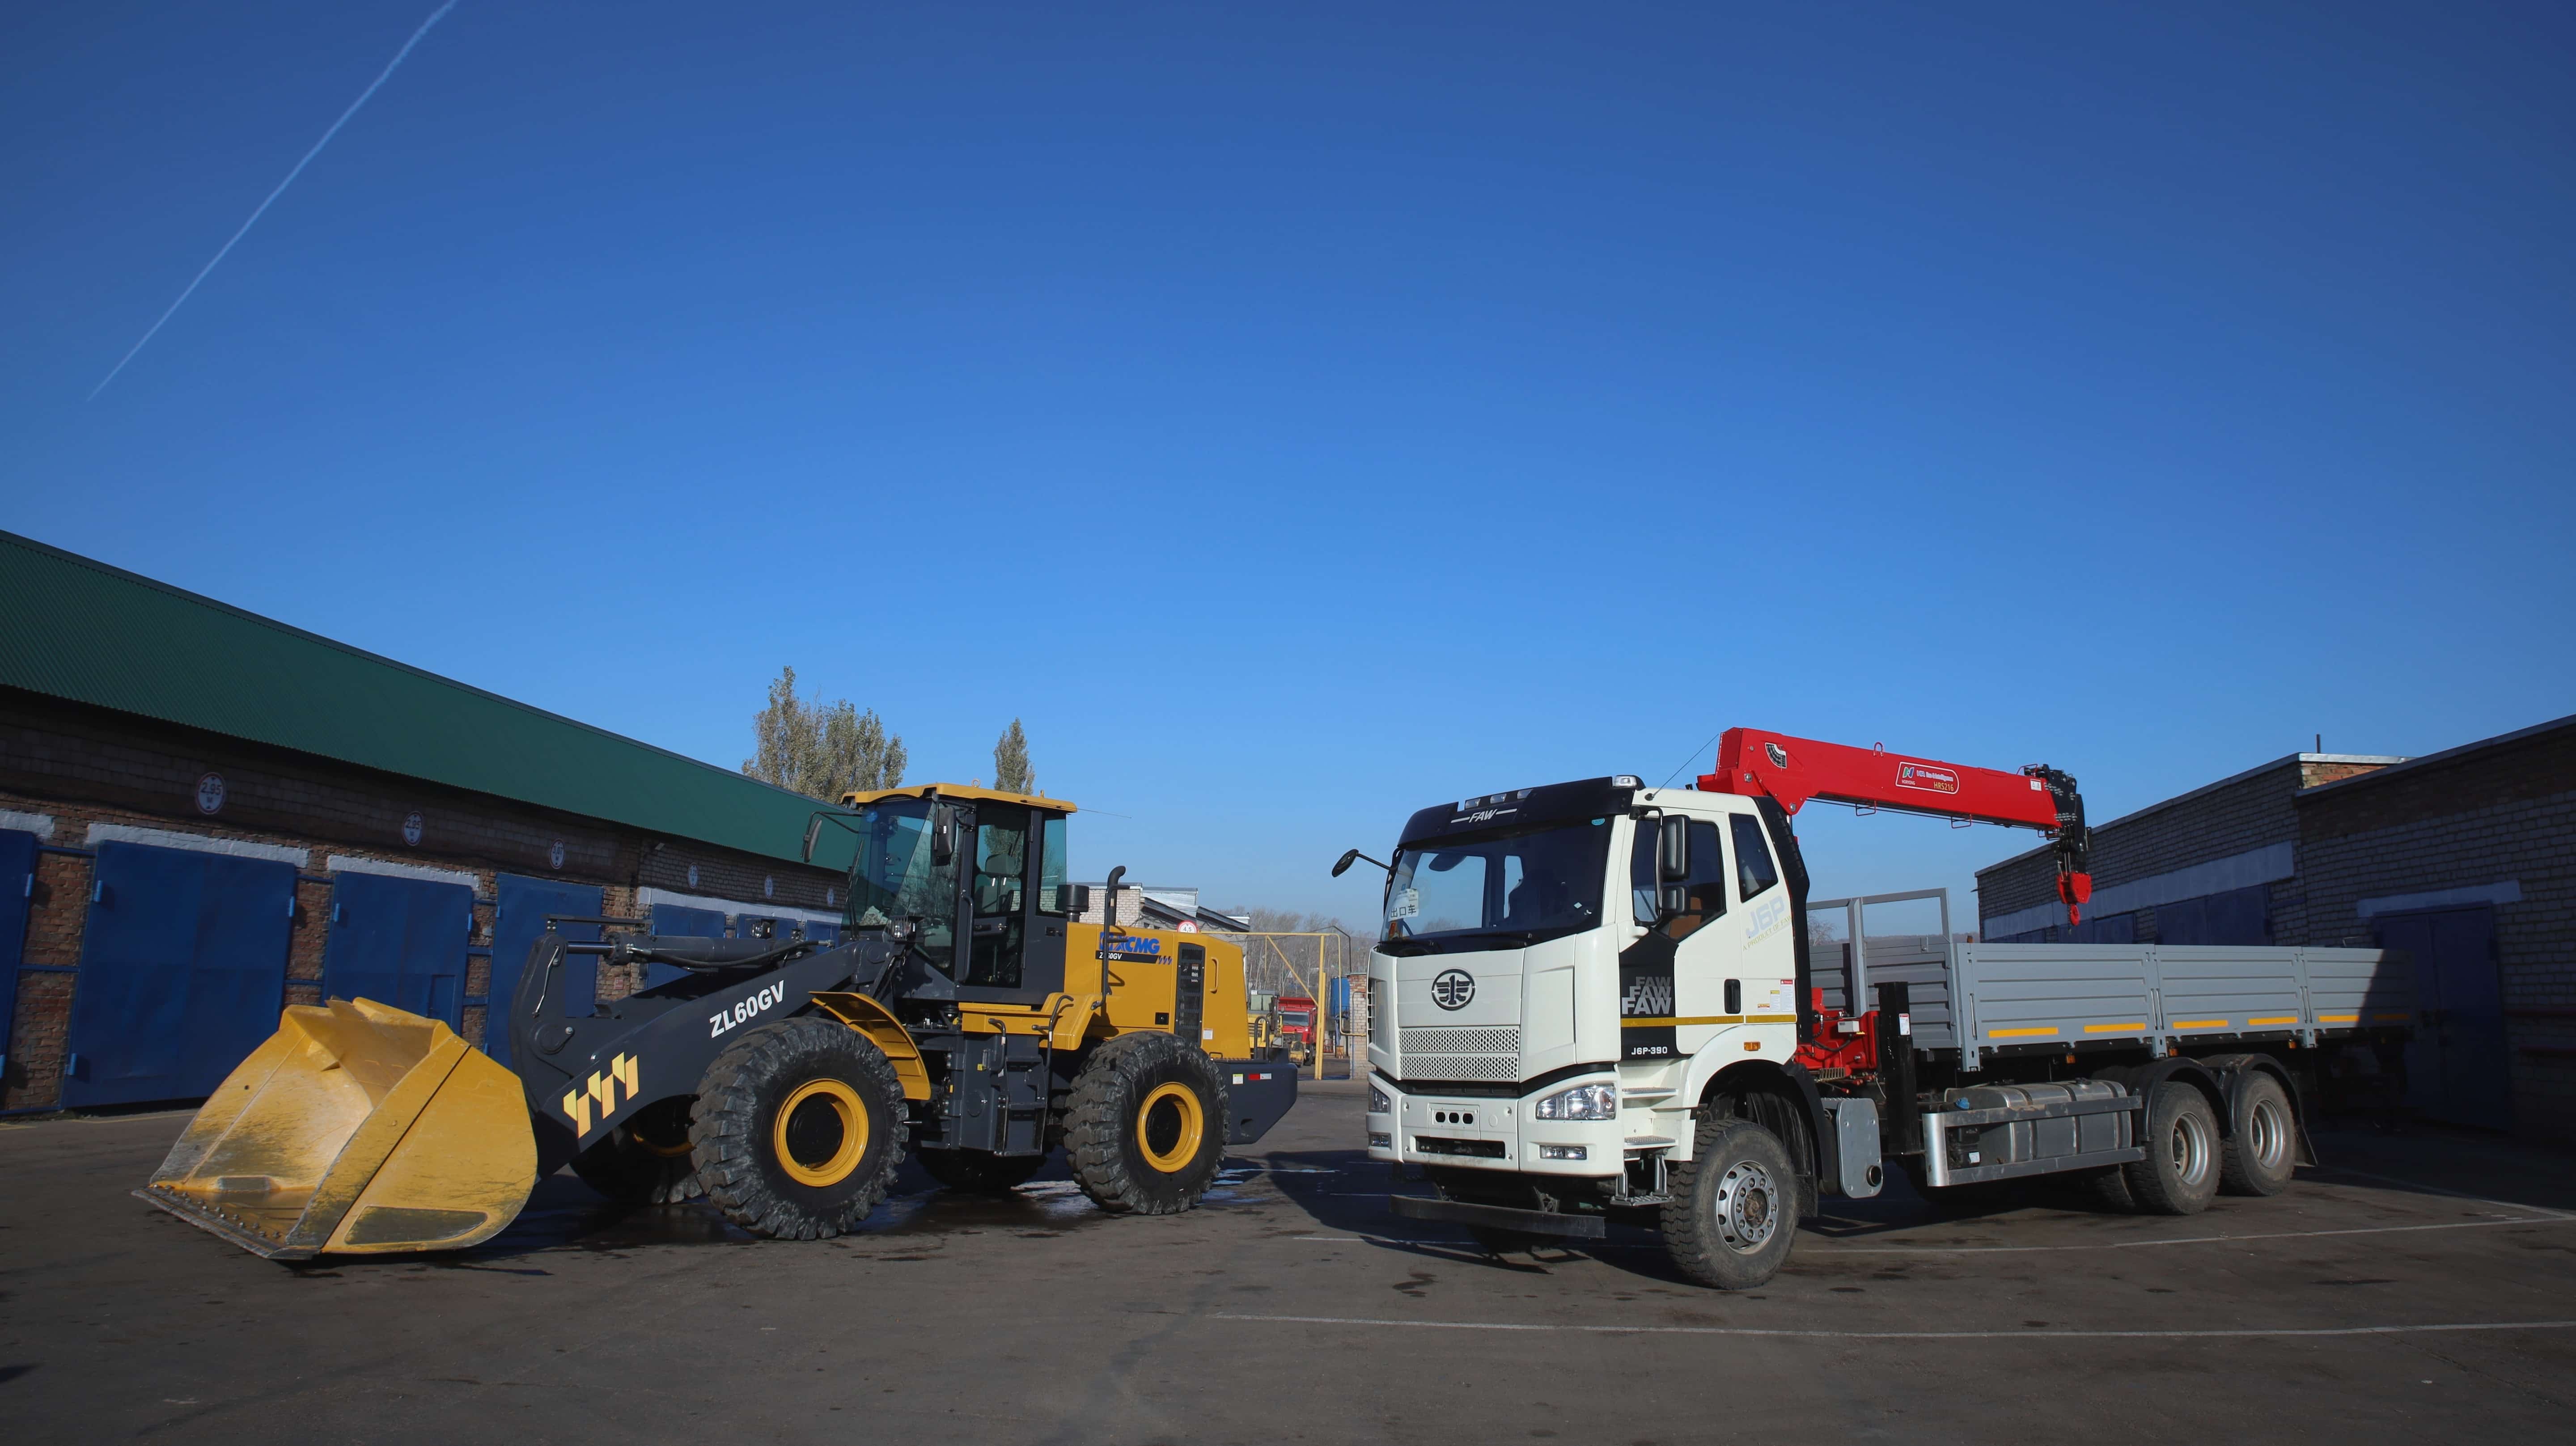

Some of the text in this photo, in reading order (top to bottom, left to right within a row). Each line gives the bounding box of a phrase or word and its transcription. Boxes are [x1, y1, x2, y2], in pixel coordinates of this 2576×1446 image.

[1933, 781, 1954, 791] HRS216
[1469, 809, 1498, 823] FAW
[1390, 904, 1416, 917] 出口车
[1746, 895, 1785, 938] J6P
[1629, 986, 1671, 998] FAW
[709, 980, 784, 1038] ZL60GV
[1622, 997, 1672, 1015] FAW
[1631, 1046, 1668, 1055] J6P-390
